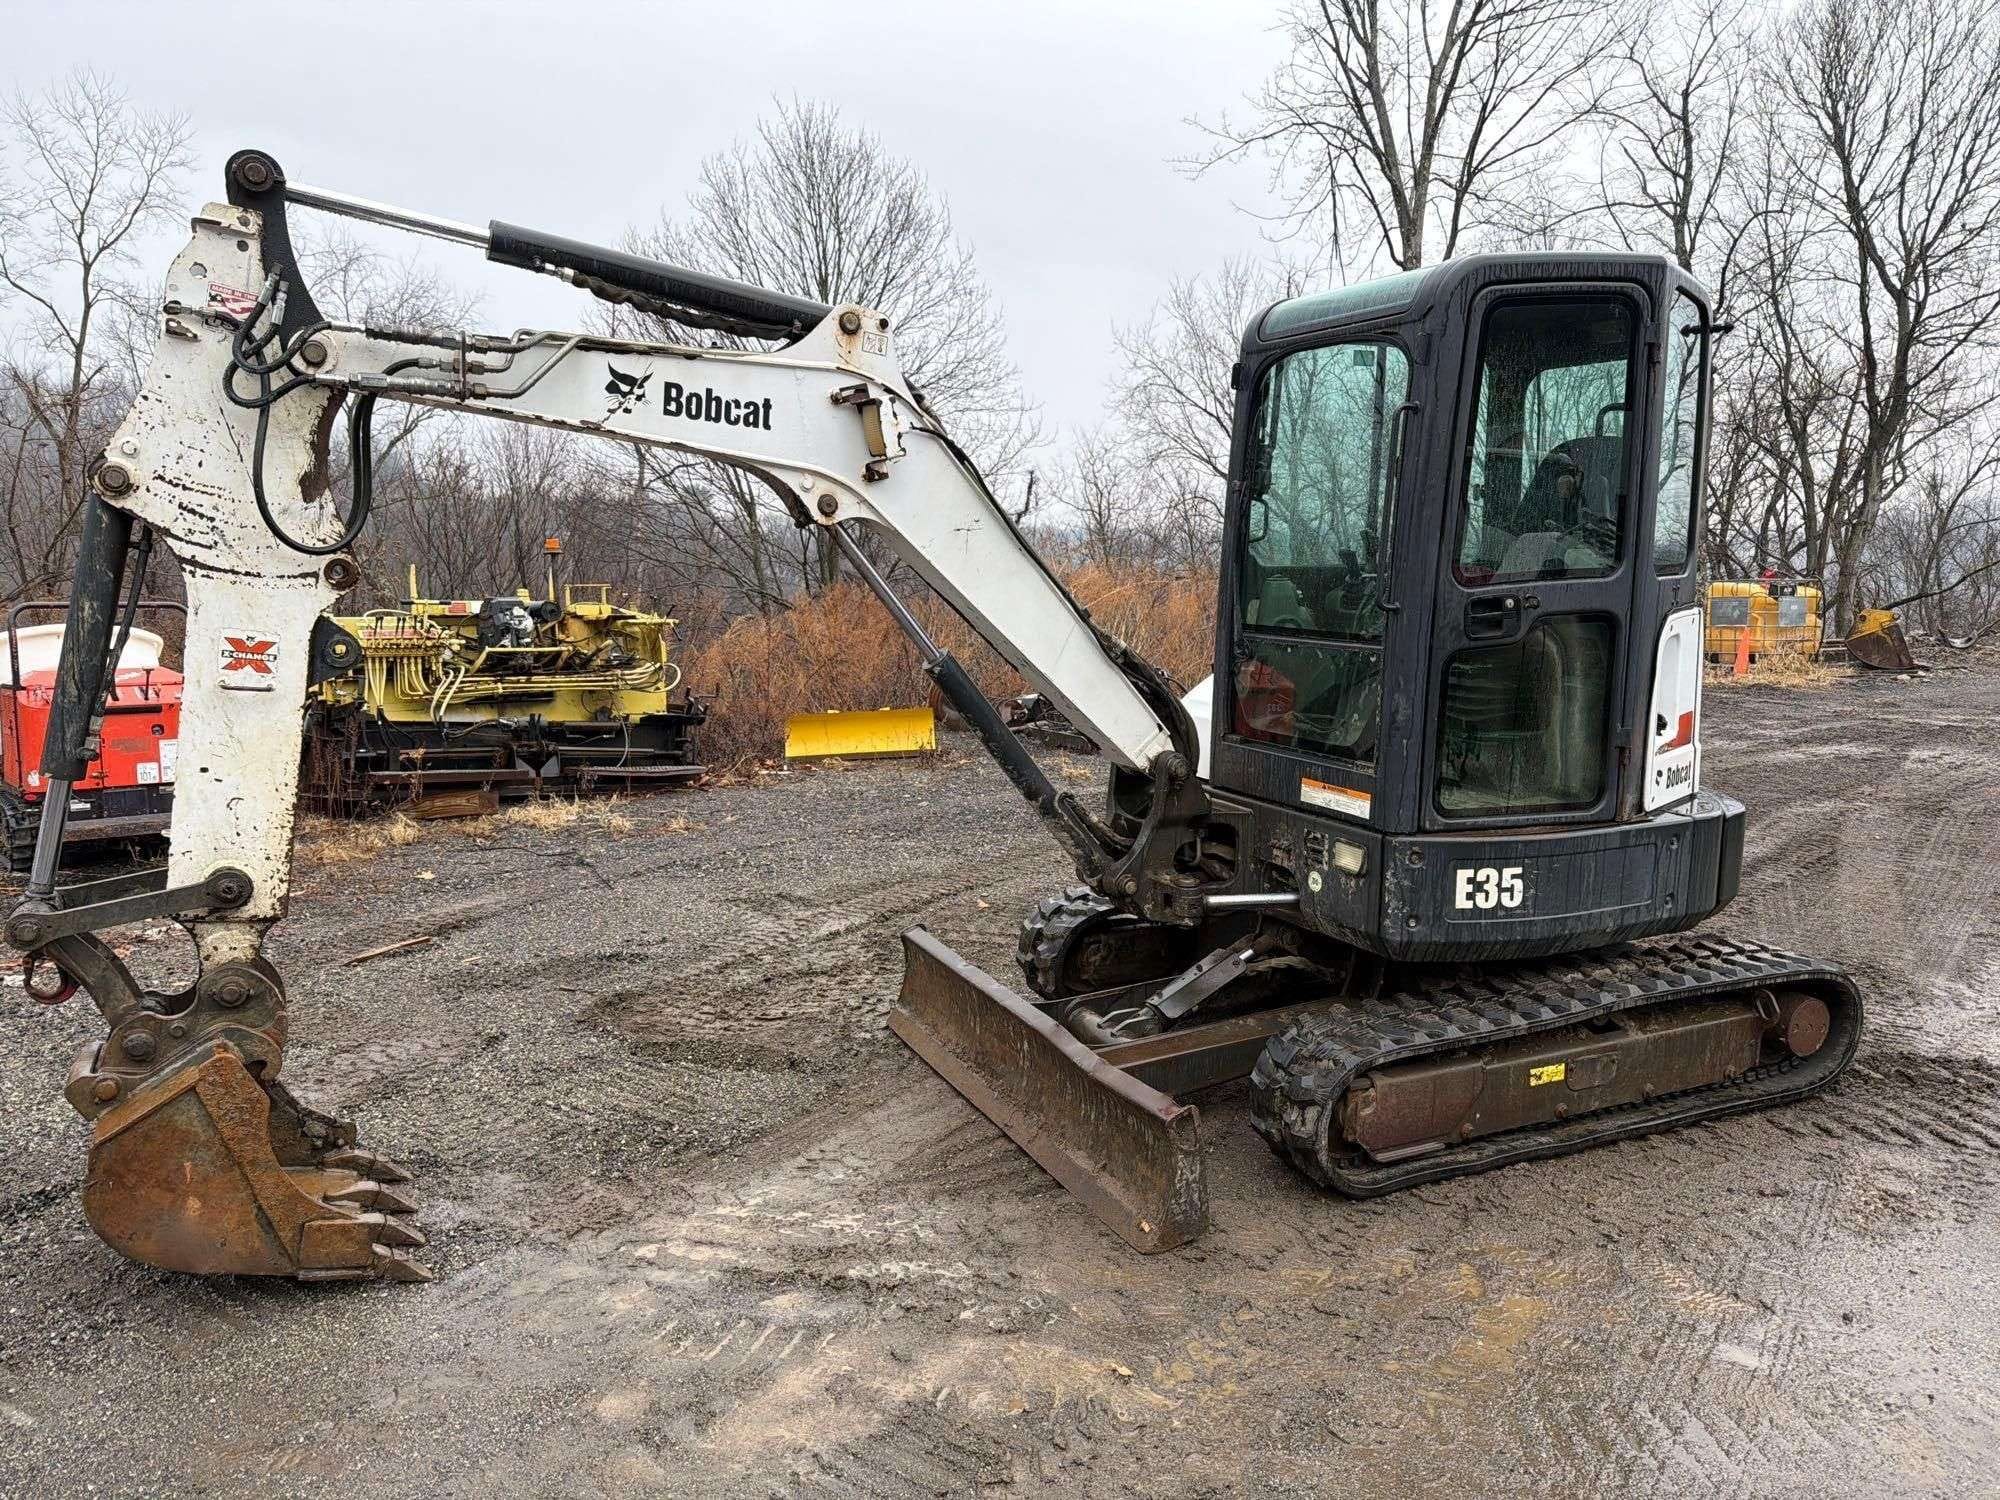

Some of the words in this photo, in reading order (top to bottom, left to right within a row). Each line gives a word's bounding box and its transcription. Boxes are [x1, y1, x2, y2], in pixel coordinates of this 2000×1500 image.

[211, 284, 233, 296] MADE
[242, 292, 257, 301] THE
[663, 381, 772, 431] Bobcat
[1666, 760, 1692, 790] Bobcat
[1455, 866, 1524, 910] E35
